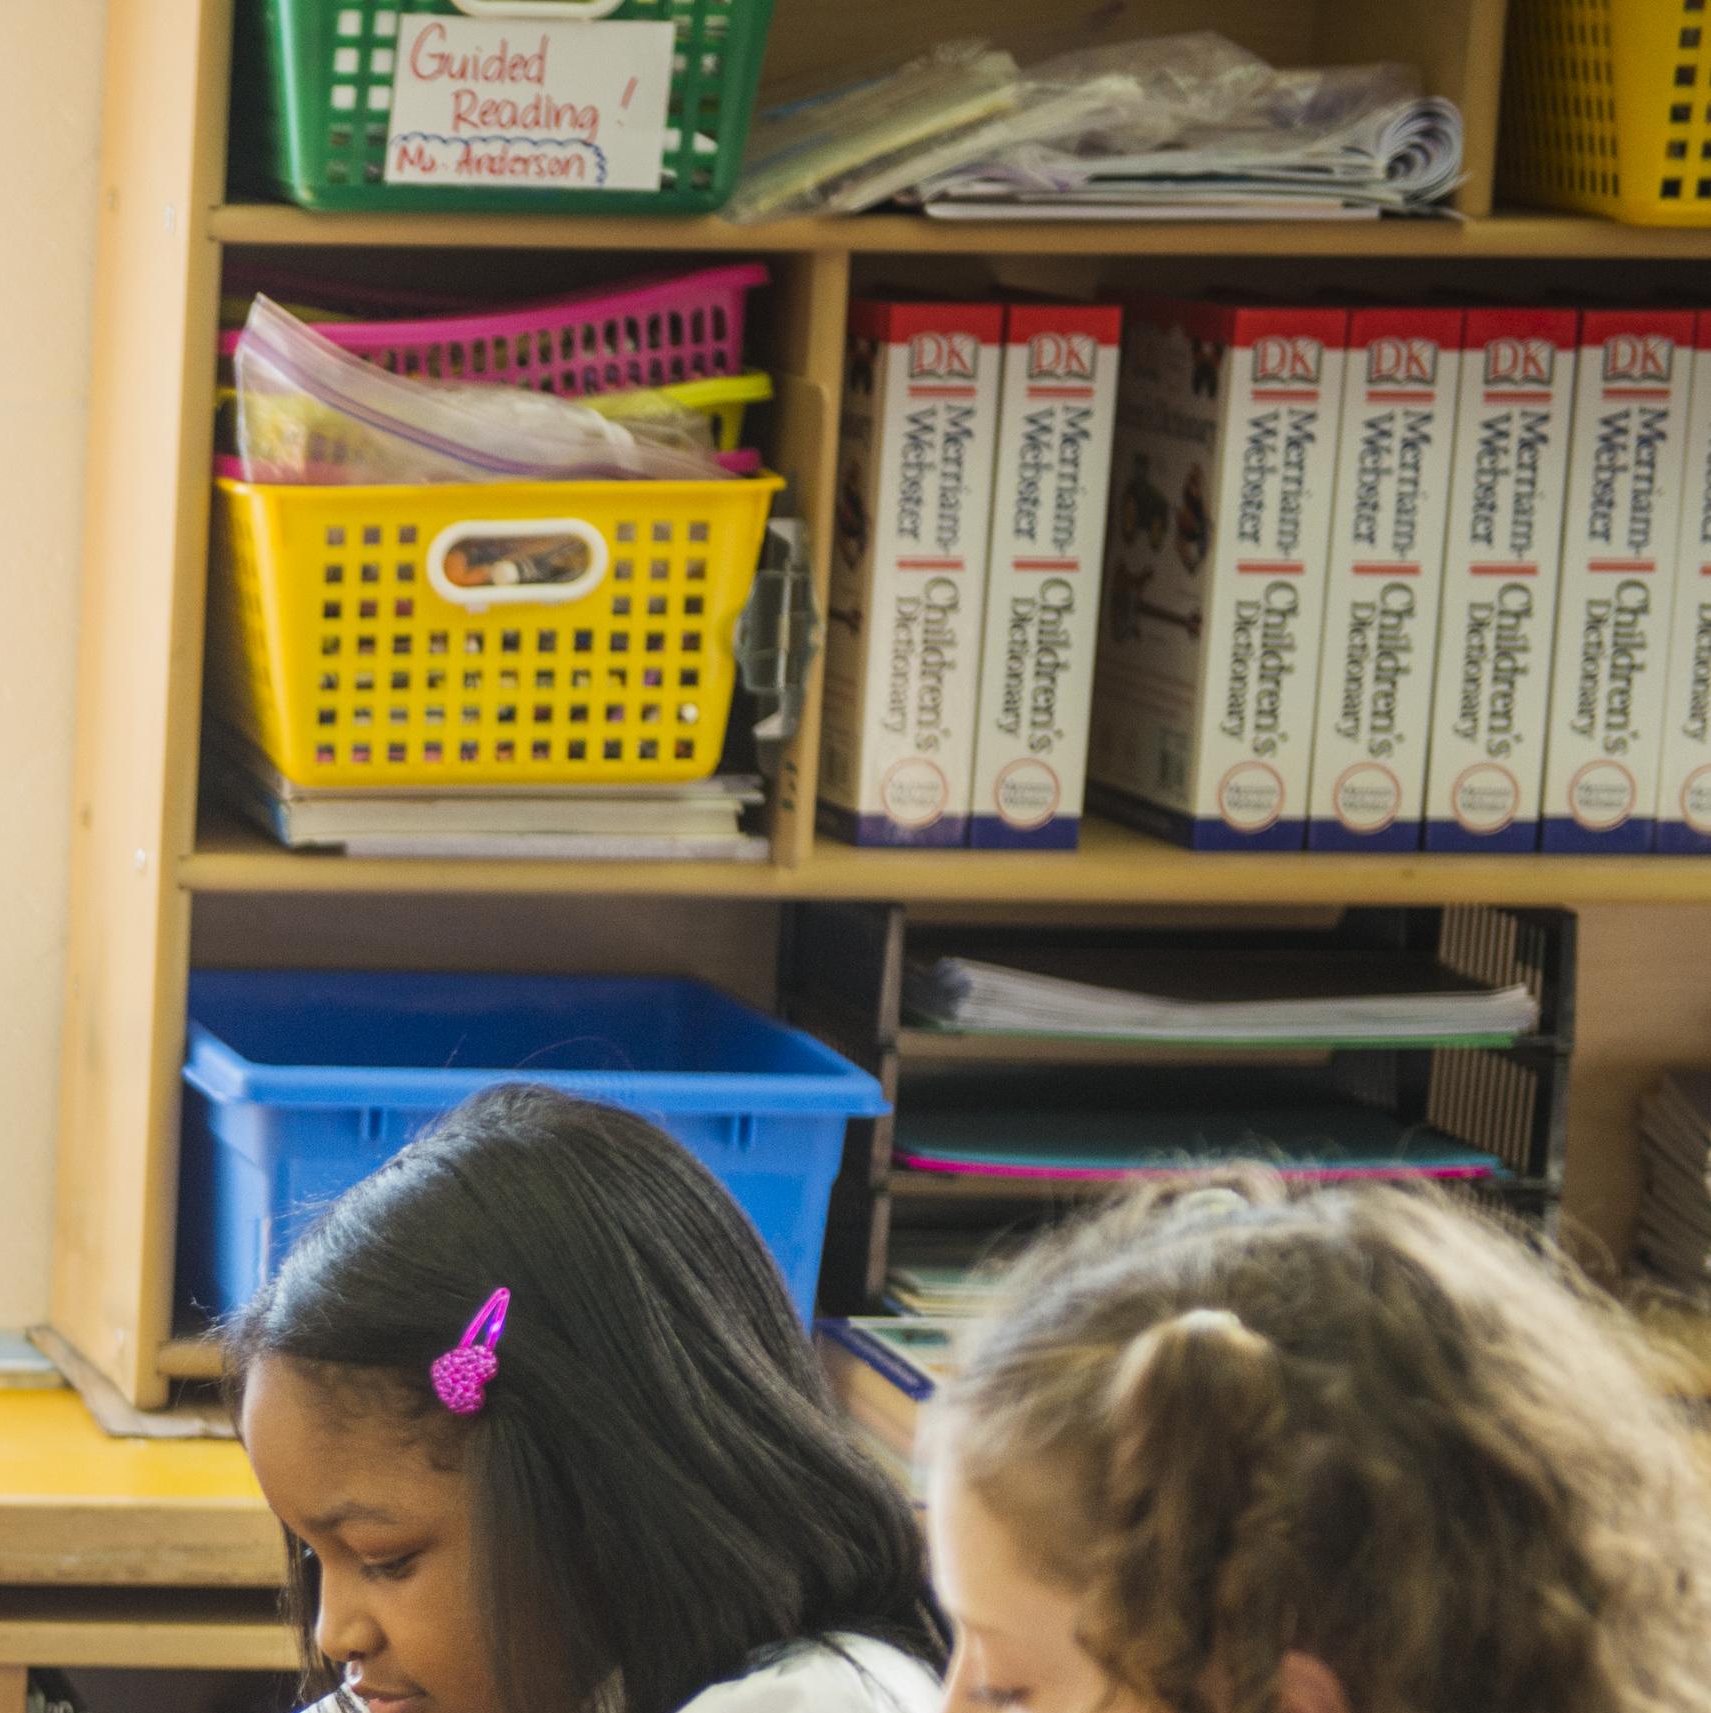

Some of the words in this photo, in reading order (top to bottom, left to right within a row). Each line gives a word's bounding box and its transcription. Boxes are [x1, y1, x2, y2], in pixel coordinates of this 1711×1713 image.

[410, 22, 550, 86] Guided
[456, 142, 586, 180] Anderson
[913, 334, 973, 373] DK
[1032, 334, 1091, 373] DK
[1258, 339, 1314, 377] DK
[1372, 340, 1428, 377] DK
[1492, 340, 1545, 379] DK
[1610, 336, 1664, 373] DK
[897, 407, 938, 540] Webster
[1013, 407, 1055, 541] Webster
[1238, 411, 1280, 546] Webster
[1353, 412, 1395, 545] Webster
[1471, 412, 1511, 547] Webster
[1589, 410, 1631, 543] Webster
[881, 596, 920, 737] Dictionary
[915, 577, 960, 752] Children's
[996, 597, 1036, 740] Dictionary
[1029, 577, 1075, 752] Children's
[1219, 600, 1261, 743] Dictionary
[1253, 581, 1298, 757] Children's
[1335, 601, 1376, 743] Dictionary
[1369, 582, 1415, 758] Children's
[1453, 602, 1494, 743] Dictionary
[1486, 583, 1533, 758] Children's
[1570, 598, 1612, 739] Dictionary
[1604, 579, 1650, 754] Children's
